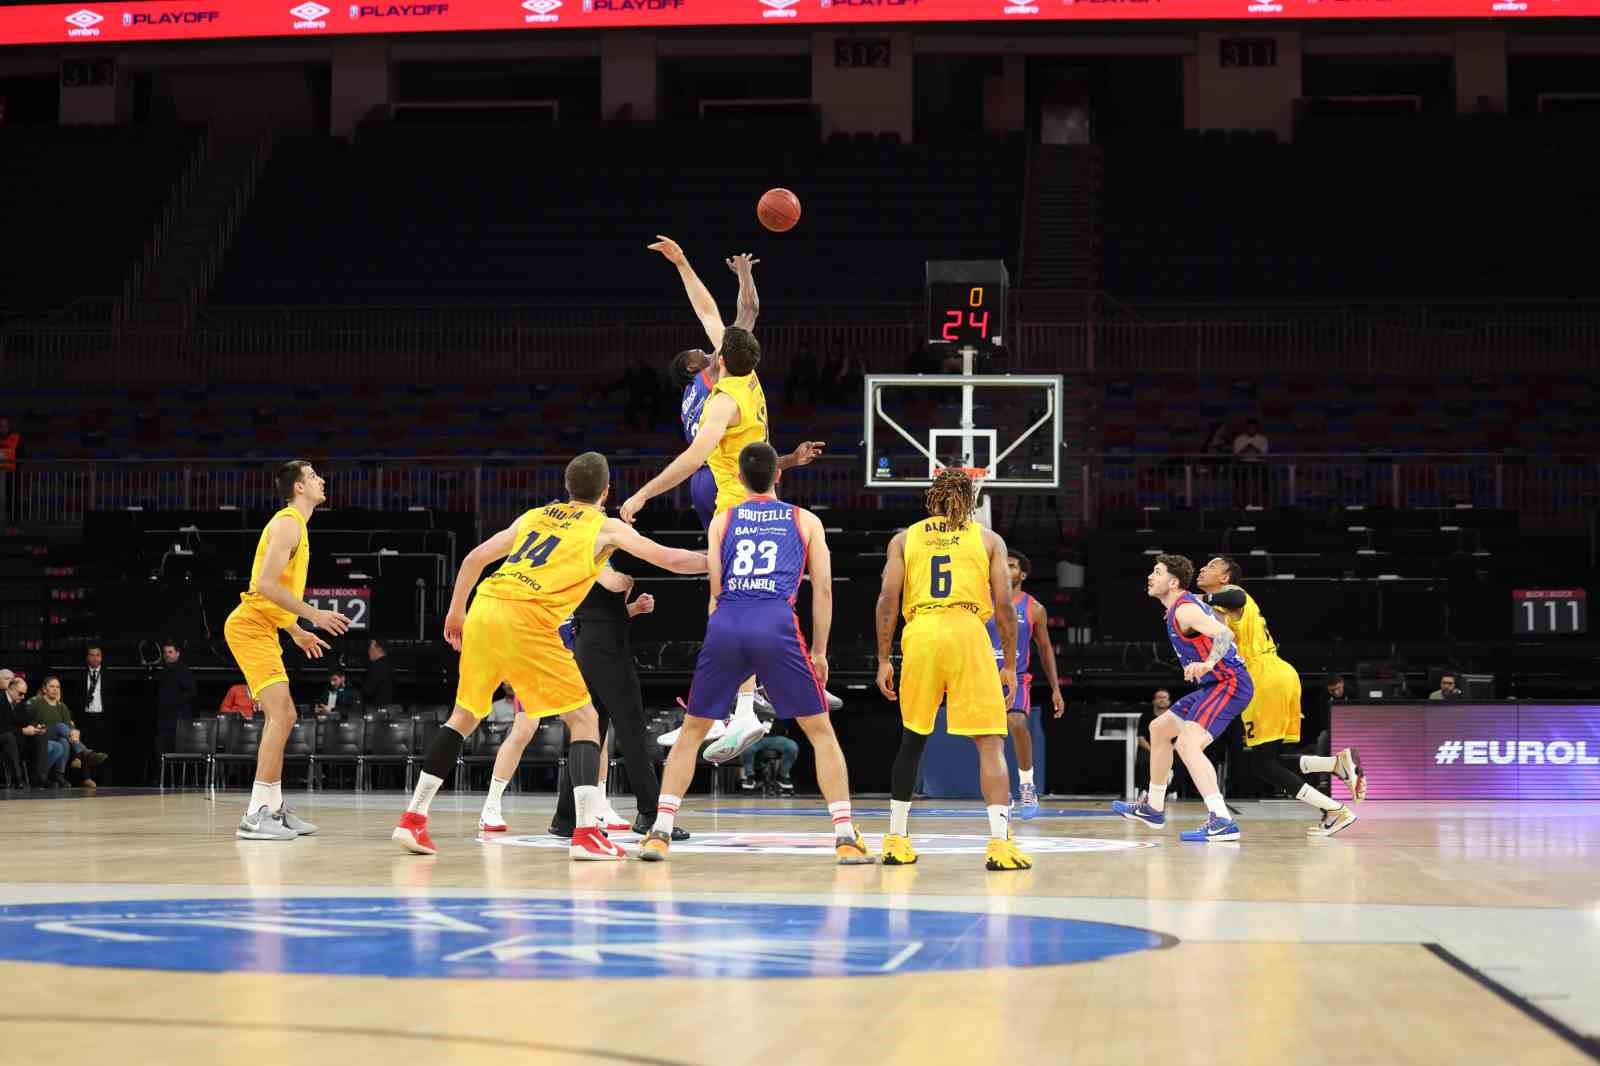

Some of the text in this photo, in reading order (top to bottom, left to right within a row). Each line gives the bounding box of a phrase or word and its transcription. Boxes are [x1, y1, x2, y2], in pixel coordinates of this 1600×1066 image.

[133, 11, 219, 24] PLAYOFF
[360, 4, 448, 17] PLAYOFF
[525, 14, 559, 22] umbro
[68, 28, 100, 37] umbro
[293, 20, 326, 30] umbro
[839, 40, 889, 66] 312
[1224, 40, 1272, 66] 311
[970, 287, 983, 307] 0
[942, 310, 989, 340] 24
[737, 508, 792, 522] BOUTEILLE
[507, 530, 561, 568] 14
[732, 539, 778, 576] 83
[931, 555, 952, 599] 6
[1521, 600, 1579, 632] 111
[1434, 740, 1600, 765] #EUROL
